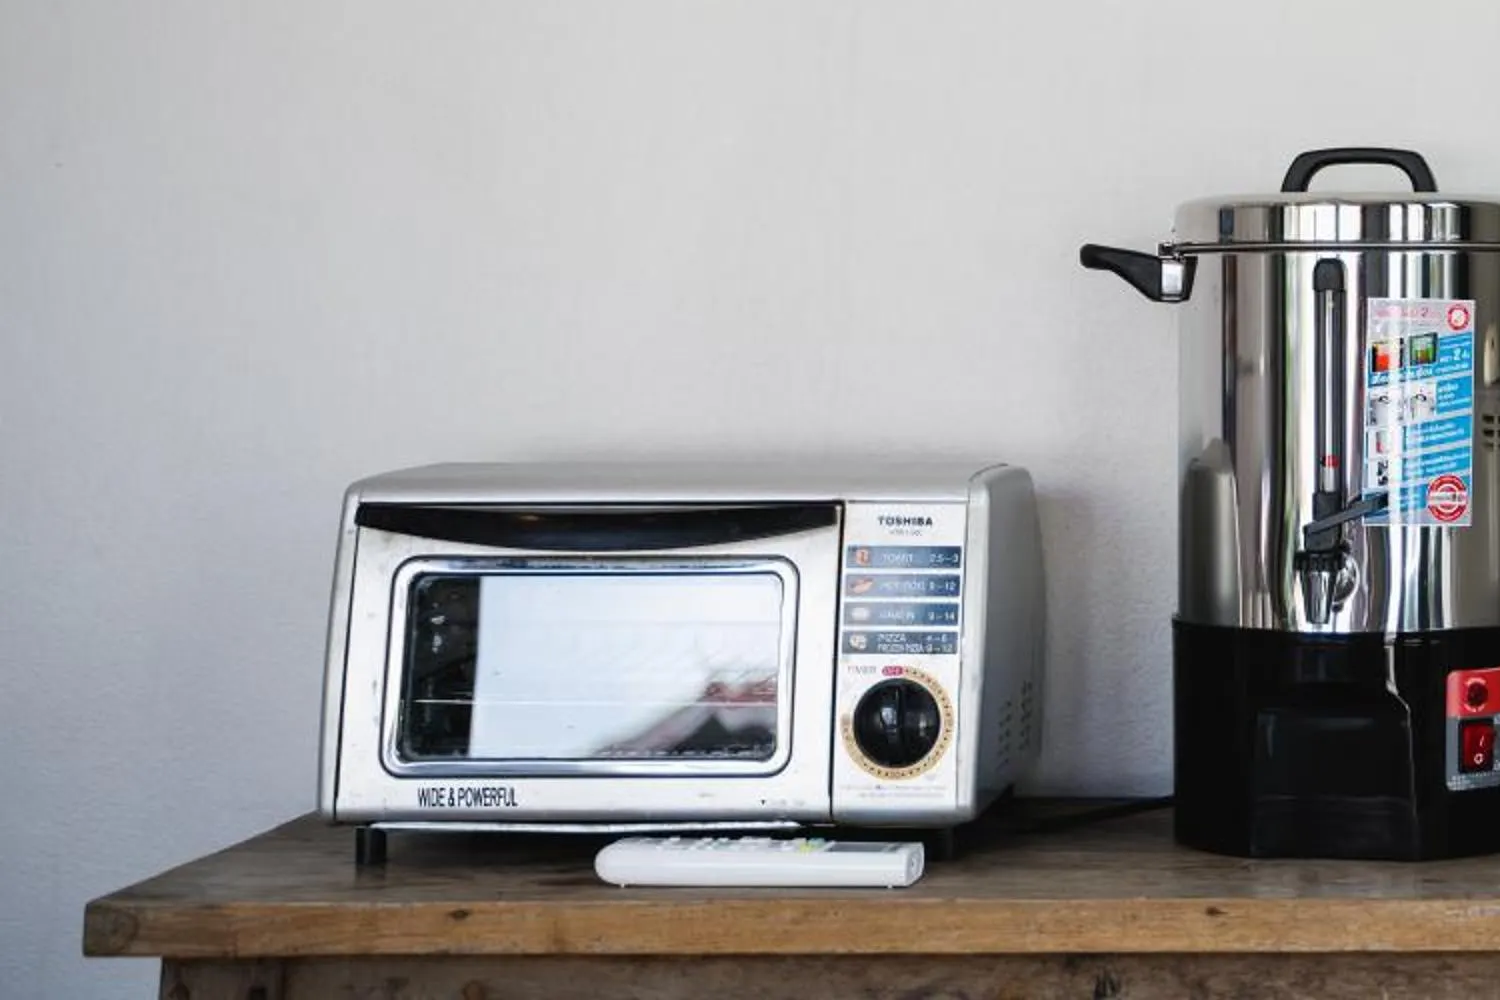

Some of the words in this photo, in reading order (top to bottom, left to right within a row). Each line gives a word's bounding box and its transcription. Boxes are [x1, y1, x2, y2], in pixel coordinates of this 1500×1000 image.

[877, 515, 933, 526] TOSHIBA
[417, 787, 446, 807] WIDE
[447, 787, 455, 807] &
[457, 787, 519, 807] POWERFUL
